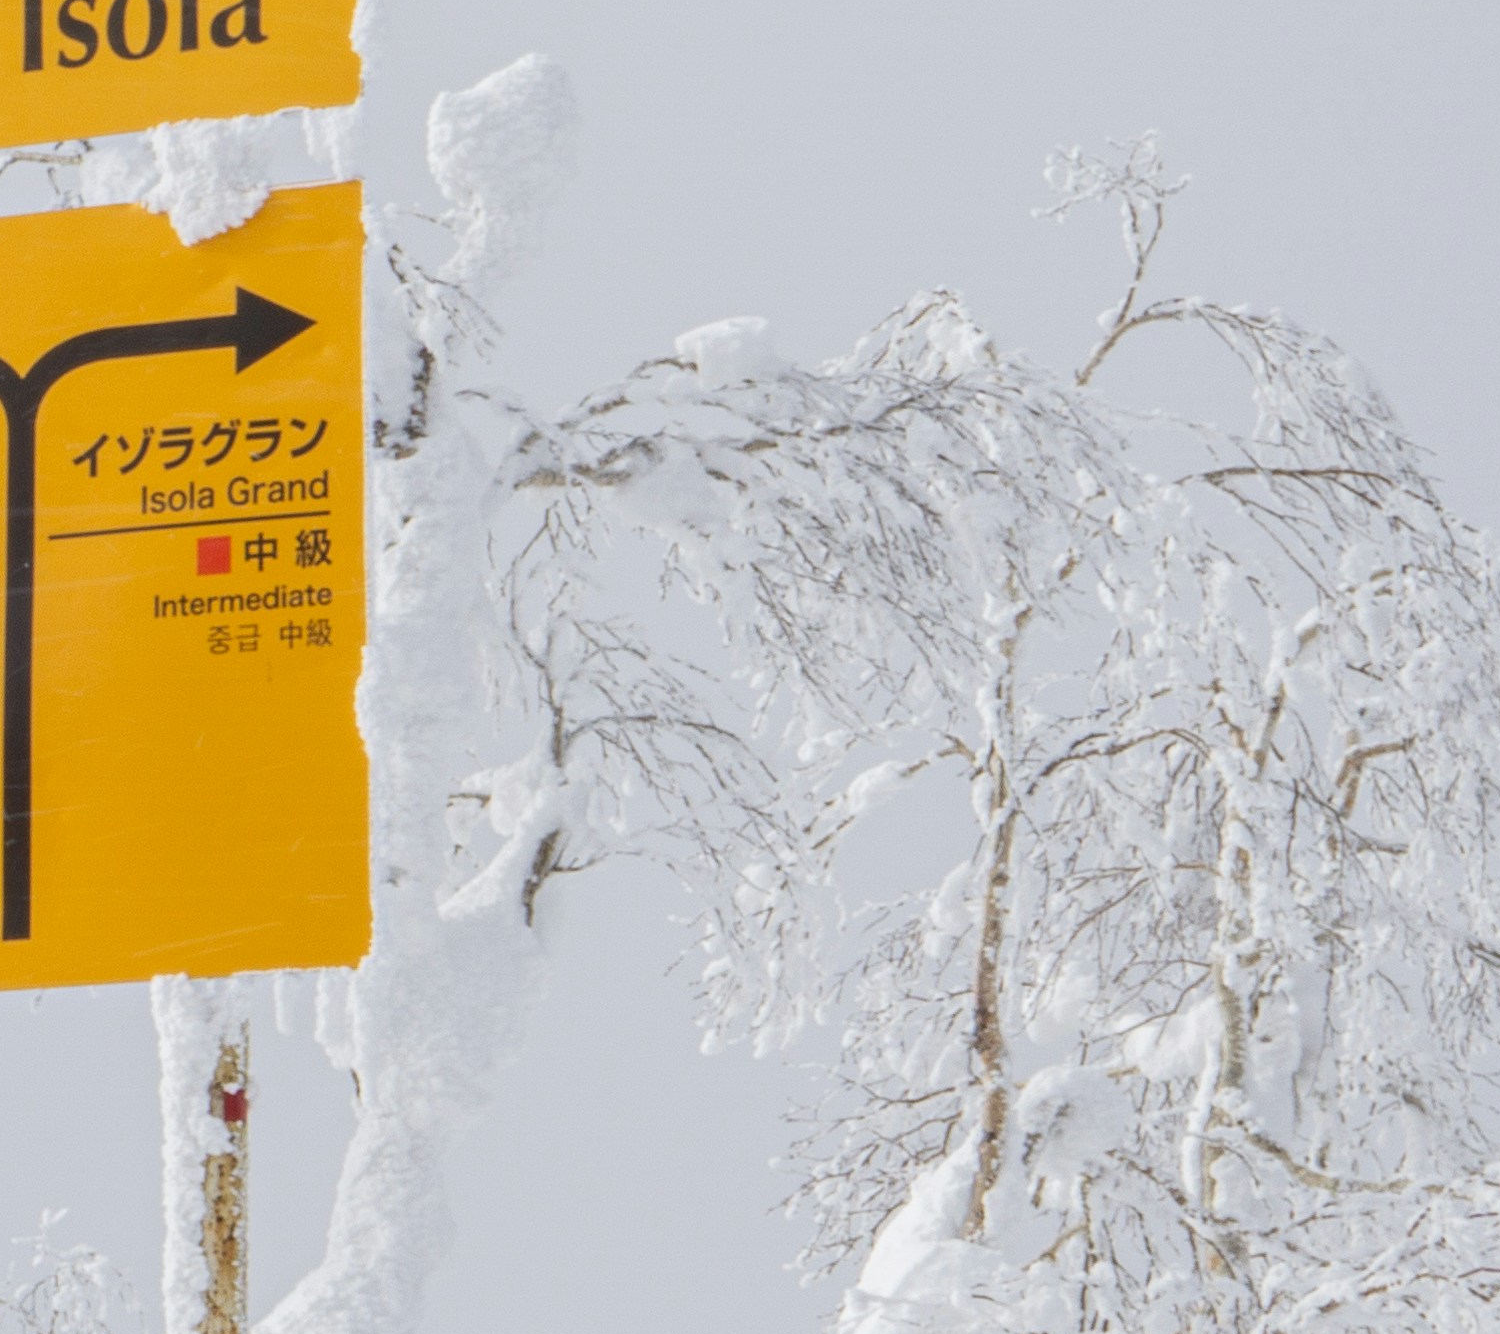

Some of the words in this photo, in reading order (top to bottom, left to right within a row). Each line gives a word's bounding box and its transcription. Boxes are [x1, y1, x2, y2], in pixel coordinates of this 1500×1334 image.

[73, 419, 328, 478] イゾラグラン
[141, 481, 215, 514] Isola
[227, 470, 329, 506] Grand
[154, 584, 332, 618] Intermediate
[208, 624, 261, 655] 중급
[279, 619, 332, 649] 中級
